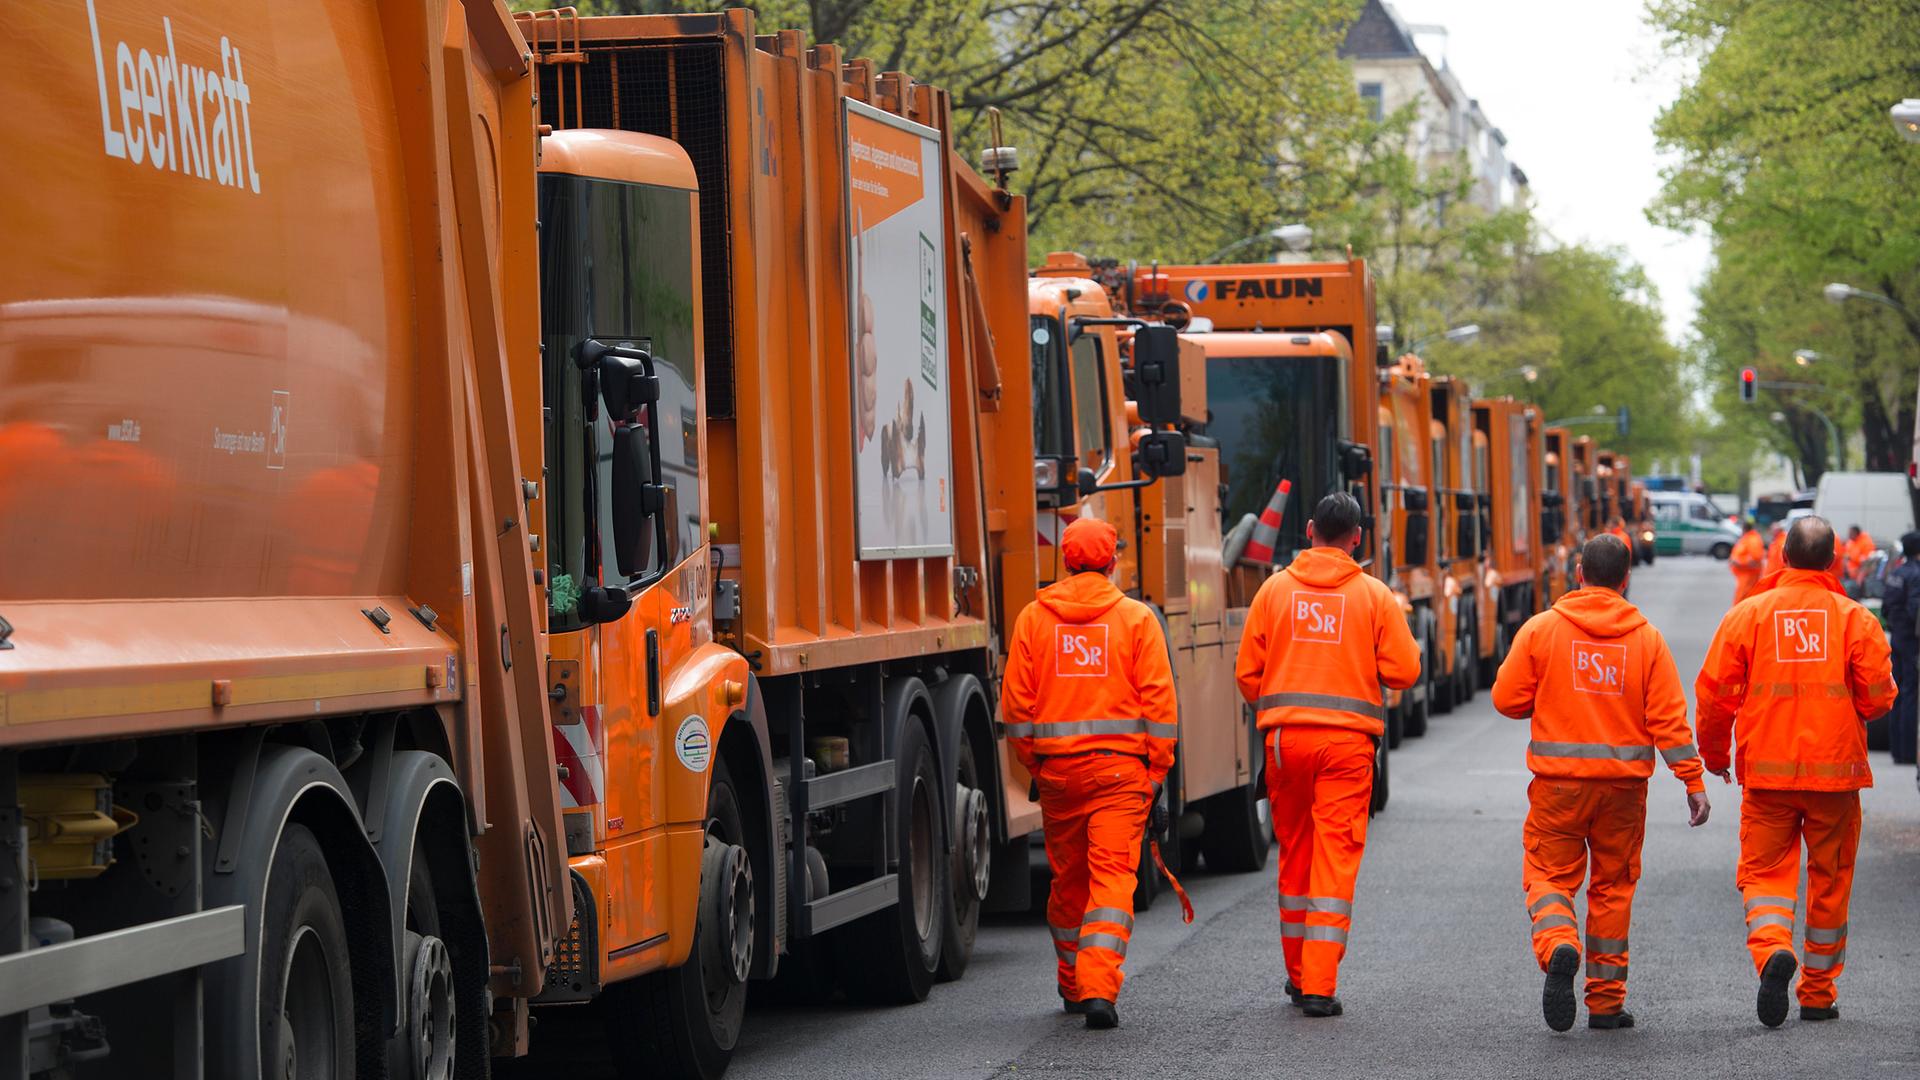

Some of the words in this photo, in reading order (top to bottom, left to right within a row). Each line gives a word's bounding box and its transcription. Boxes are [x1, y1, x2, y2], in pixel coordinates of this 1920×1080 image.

[86, 0, 261, 194] Leerkraft
[1215, 277, 1322, 300] FAUN
[1297, 600, 1336, 634] BSR
[1062, 634, 1102, 667] BSR
[1783, 617, 1821, 653] BSR
[1576, 651, 1617, 686] BSR
